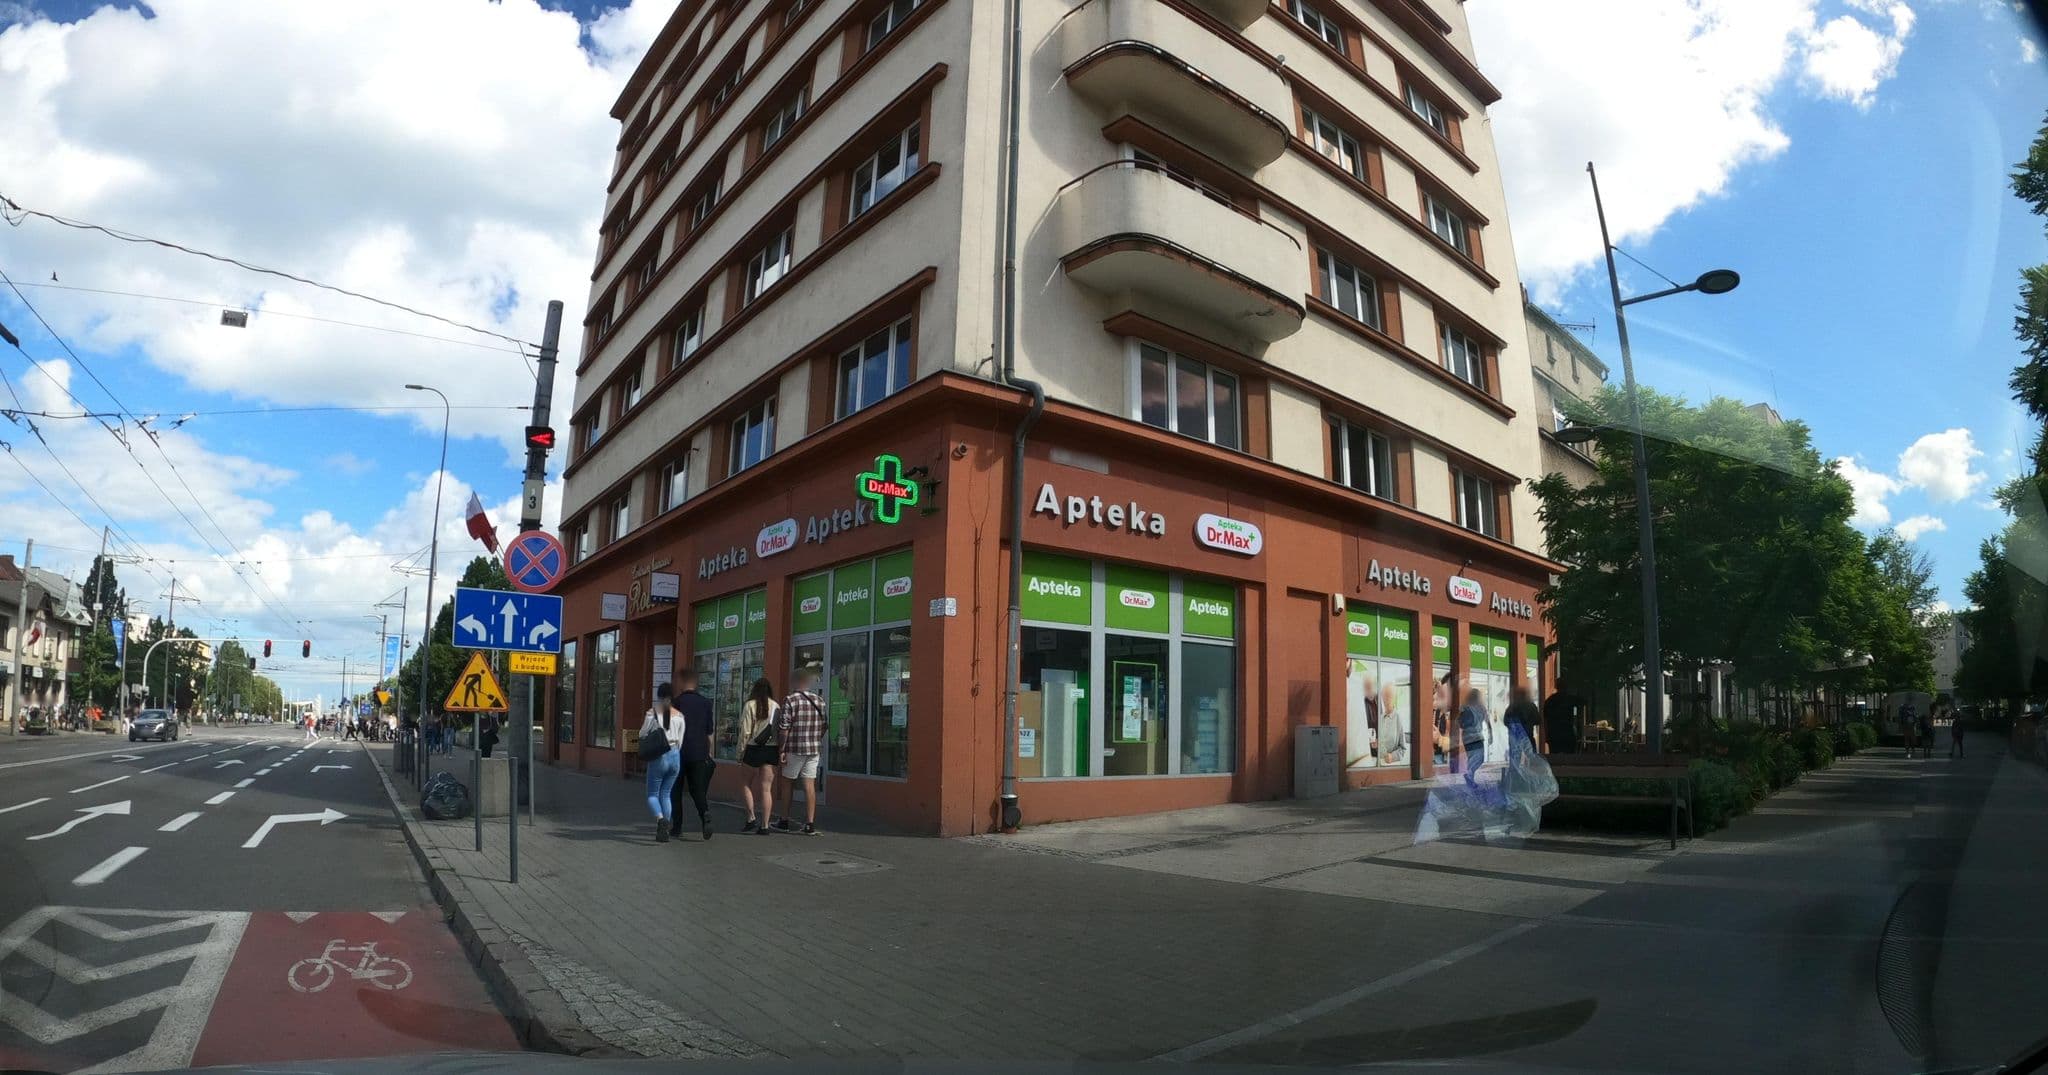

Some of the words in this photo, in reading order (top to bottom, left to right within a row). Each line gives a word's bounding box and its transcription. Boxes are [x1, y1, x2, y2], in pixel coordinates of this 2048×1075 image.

[868, 480, 907, 497] Dr.Max
[528, 496, 537, 510] 3
[1035, 483, 1166, 535] Apteka
[804, 499, 875, 544] Aptek
[1217, 519, 1243, 532] Apteka
[760, 534, 789, 554] Dr.Max
[1207, 526, 1250, 549] Dr.Max
[698, 545, 747, 580] Apteka
[1369, 559, 1431, 593] Apteka
[886, 584, 906, 595] Dr.Max
[1028, 576, 1082, 597] Apteka
[1454, 585, 1477, 600] Dr.Max
[837, 587, 868, 606] Apteka
[1124, 596, 1148, 606] Dr.Max
[1491, 592, 1533, 618] Apteka
[1189, 599, 1229, 616] Apteka
[1384, 627, 1409, 640] Apteka
